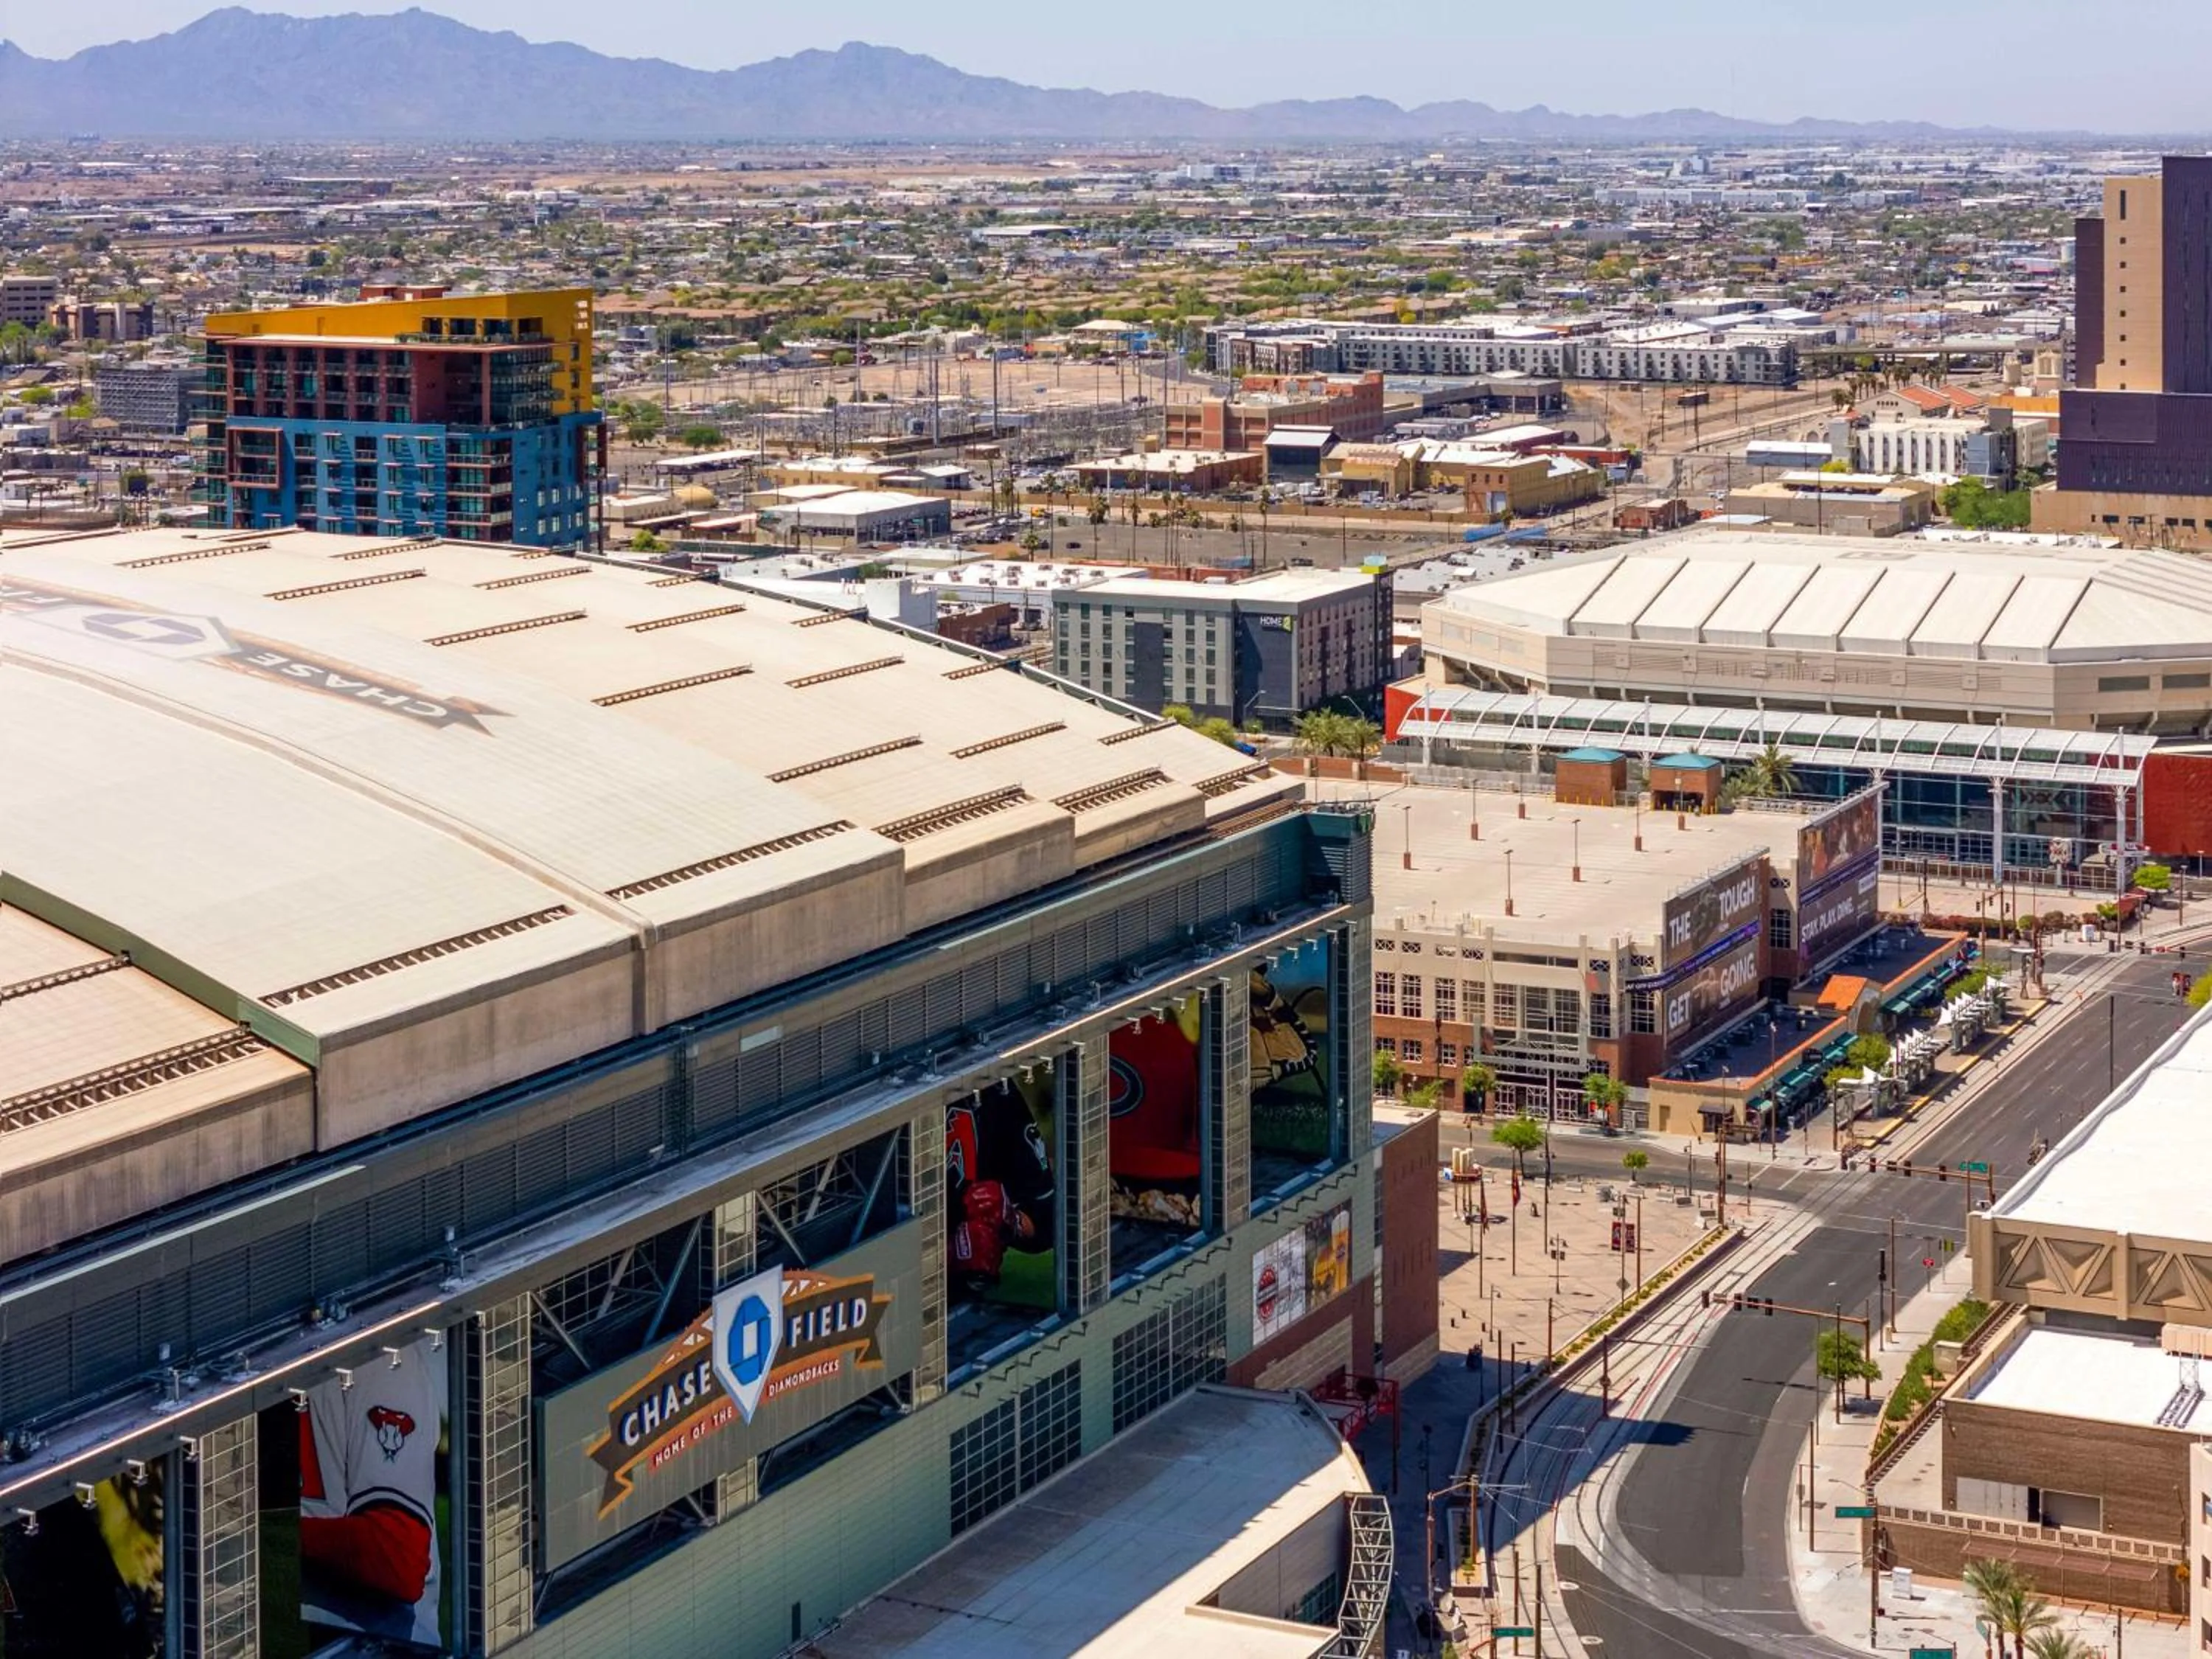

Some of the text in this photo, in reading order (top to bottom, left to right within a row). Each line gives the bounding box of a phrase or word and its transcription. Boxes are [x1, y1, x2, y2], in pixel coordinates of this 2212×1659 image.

[1260, 616, 1282, 626] HOME
[251, 651, 449, 718] CHASE
[1669, 911, 1691, 949] THE
[1719, 876, 1756, 920] TOUGH
[1669, 953, 1756, 1029] GET GOING.
[621, 1297, 868, 1447] CHASE FIELD
[655, 1359, 840, 1467] HOME OF THE DIAMONDBACKS
